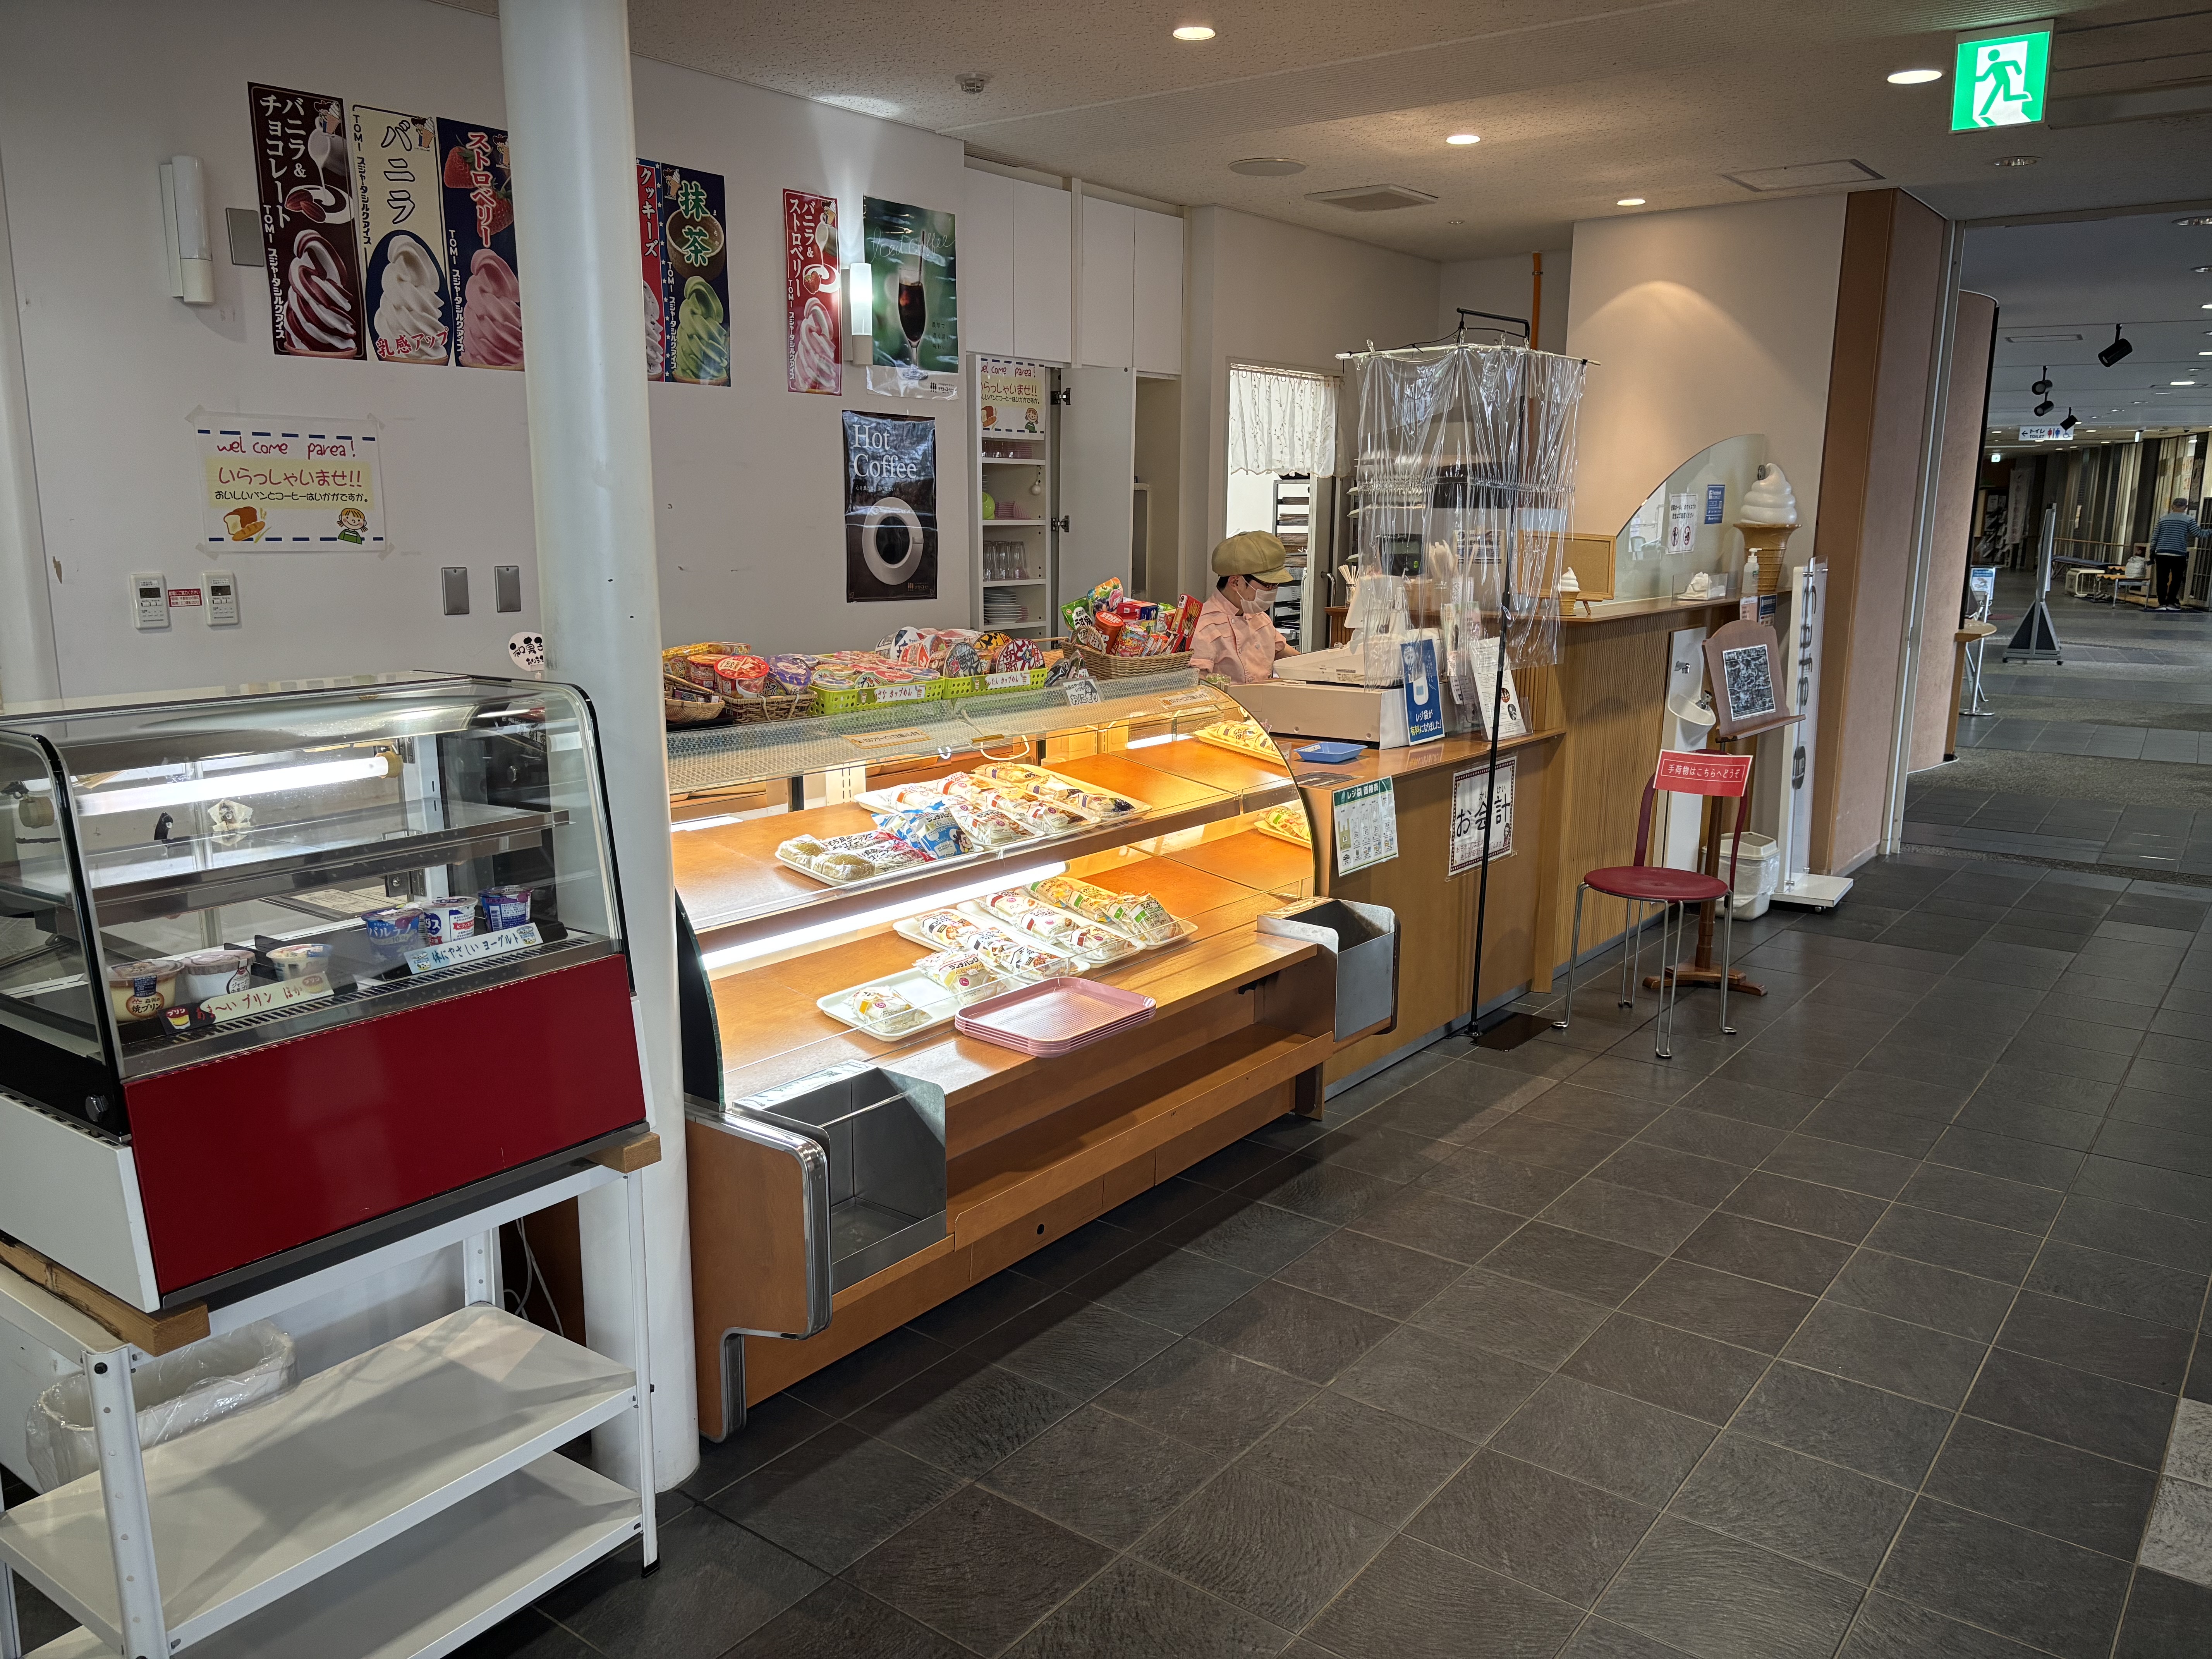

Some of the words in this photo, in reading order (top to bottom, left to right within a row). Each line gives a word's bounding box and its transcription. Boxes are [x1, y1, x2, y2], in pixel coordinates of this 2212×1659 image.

[284, 97, 307, 178] バニラ&
[353, 114, 363, 151] TOMI
[260, 94, 291, 228] チョコレート
[380, 119, 416, 225] バニラ
[467, 131, 495, 248] ストロベリー
[263, 204, 275, 243] TOMI
[641, 168, 658, 257] クッキーズ
[678, 180, 712, 267] 抹茶
[802, 201, 815, 258] バニラ&
[448, 229, 458, 264] TOMI
[789, 198, 804, 297] ストロベリー
[375, 327, 449, 358] 乳感アップ
[253, 441, 288, 454] come
[853, 424, 891, 450] Hot
[219, 467, 362, 487] いらっしゃいませ!!
[854, 453, 917, 479] Coffee
[215, 490, 368, 502] おいしいパンとコーヒーはいかがですか。
[1070, 692, 1098, 705] おにぎり
[1415, 709, 1433, 722] レジ袋が
[1668, 764, 1741, 778] 手荷物はこちらへどうぞ
[1456, 793, 1510, 837] お会計
[369, 924, 411, 938] パルテノ
[431, 944, 479, 963] 体にやさしい
[483, 933, 519, 950] ヨーグルト
[949, 957, 979, 970] ランチパック
[132, 1003, 162, 1013] 焼プリン
[167, 1008, 185, 1016] プリン
[242, 993, 271, 1008] プリン
[283, 987, 302, 999] ほか
